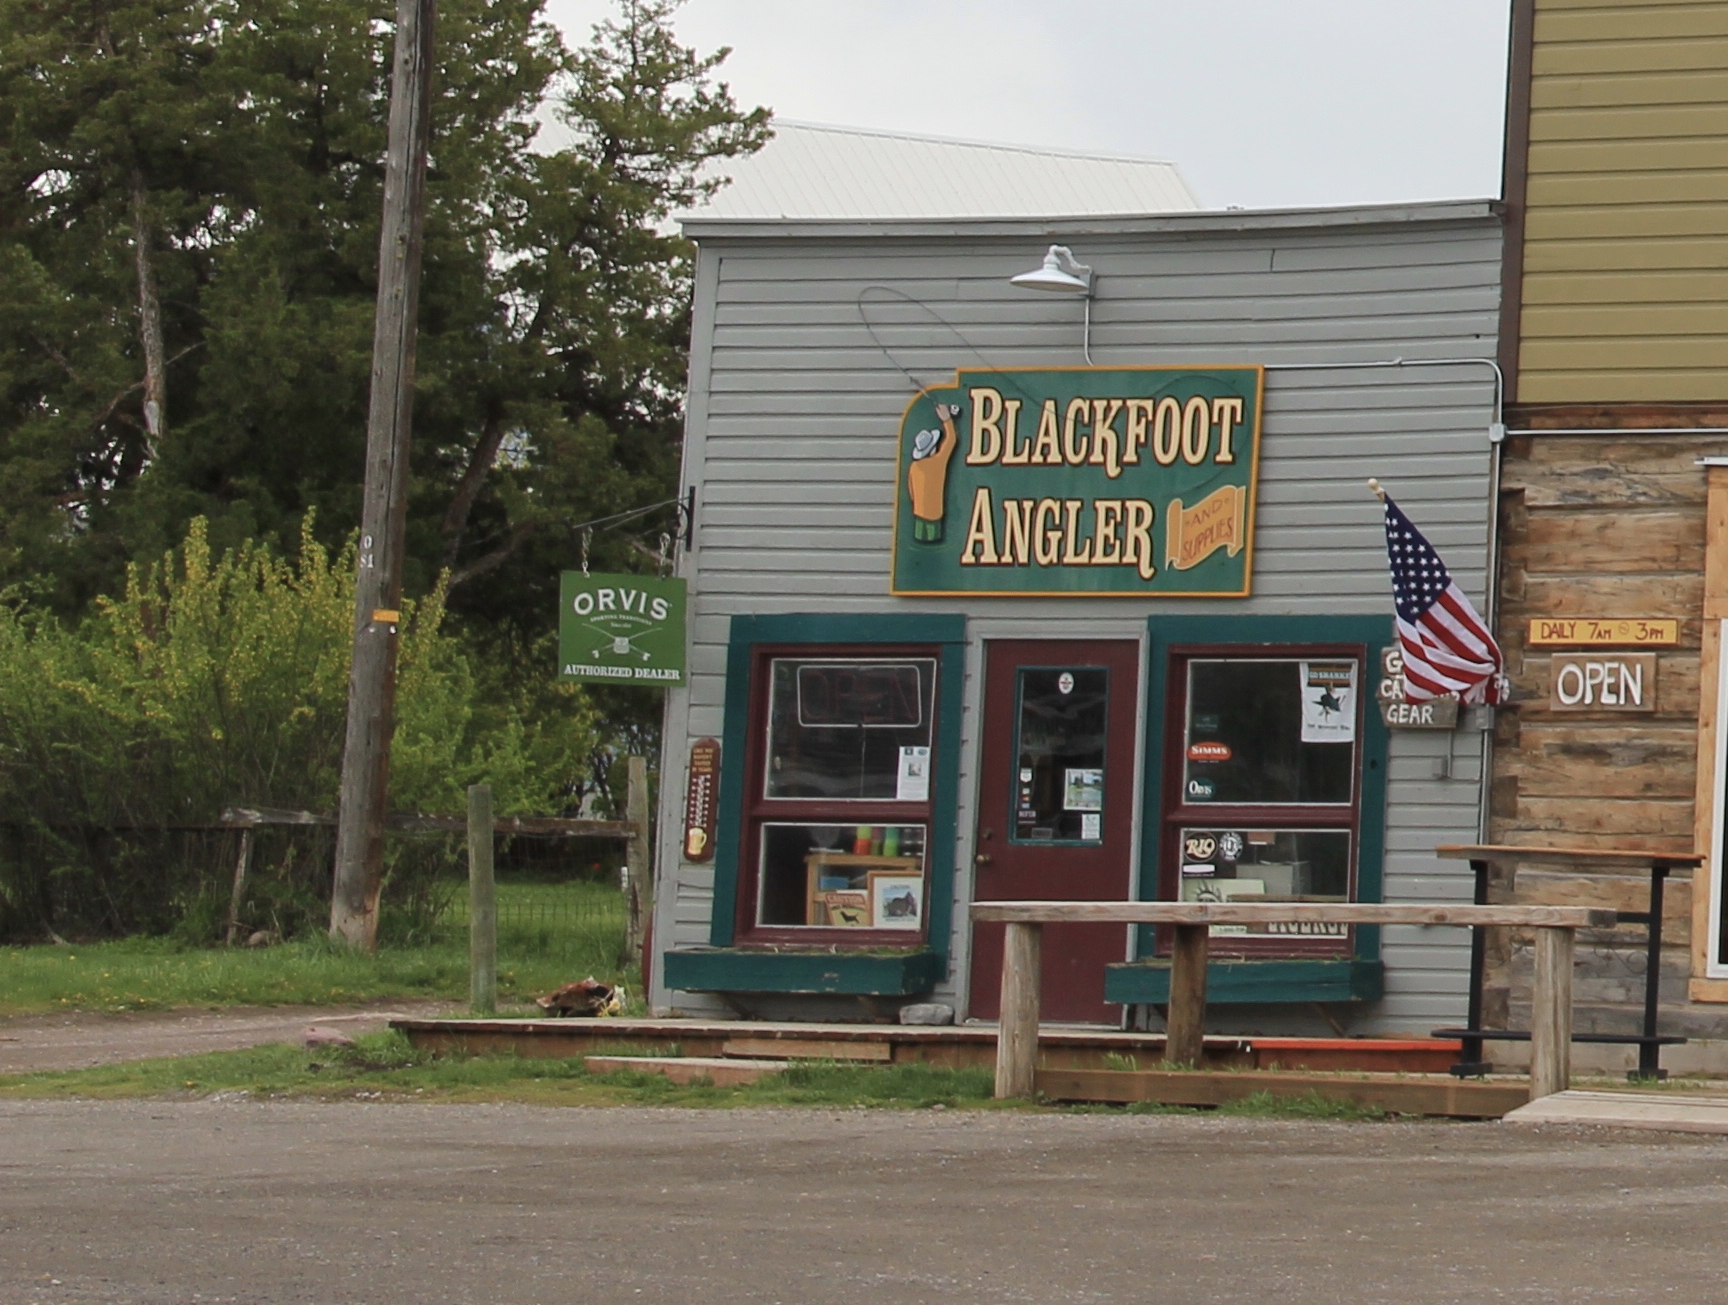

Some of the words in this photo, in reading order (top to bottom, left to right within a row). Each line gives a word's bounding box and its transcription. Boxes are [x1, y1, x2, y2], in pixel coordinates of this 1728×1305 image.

[965, 387, 1243, 479] BLACKFOOT
[960, 487, 1157, 580] ANGLER
[1182, 517, 1234, 562] SUPPLIES
[573, 588, 669, 620] ORVIS
[1541, 622, 1576, 639] DAILY
[564, 664, 632, 678] AUTHORIZED
[634, 667, 680, 680] DEALER
[1557, 662, 1642, 705] OPEN
[1386, 704, 1433, 724] GEAR
[1186, 838, 1216, 858] RIO
